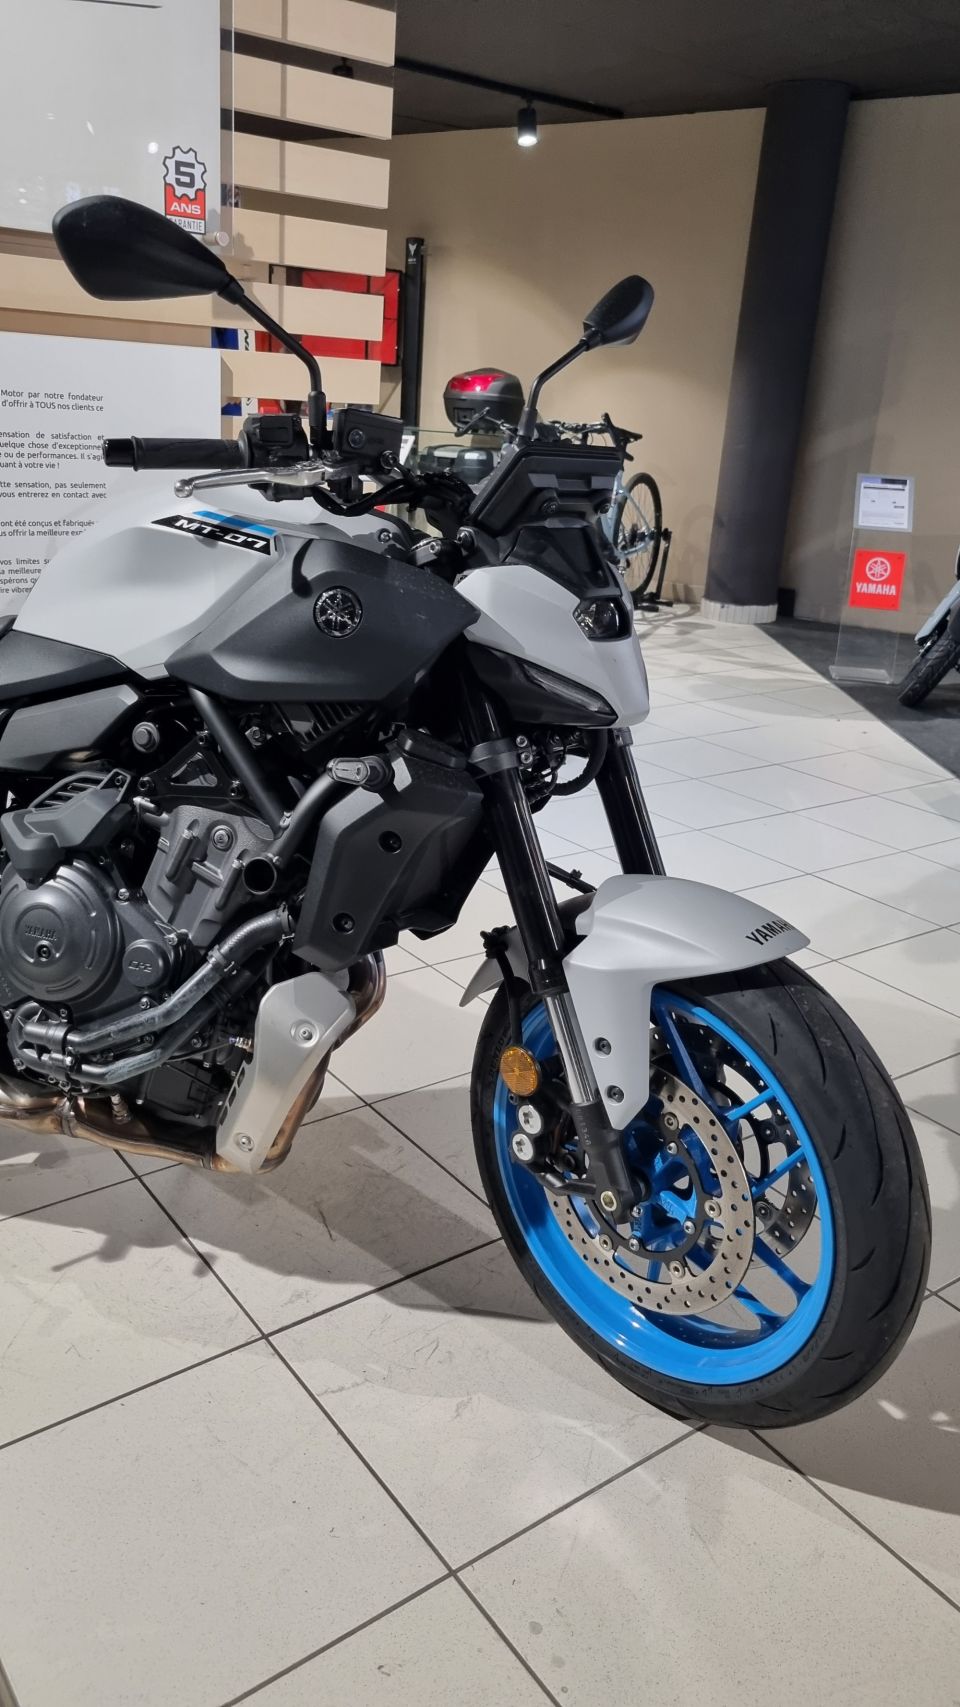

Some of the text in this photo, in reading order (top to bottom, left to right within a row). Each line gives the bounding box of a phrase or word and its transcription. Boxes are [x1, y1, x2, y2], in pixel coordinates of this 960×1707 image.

[174, 159, 196, 189] 5
[170, 202, 201, 216] ANS
[0, 389, 103, 402] Motor par notre fondateur
[1, 399, 28, 408] d'offrir
[29, 401, 34, 409] à
[36, 401, 56, 410] TOUS
[57, 402, 70, 410] nos
[72, 402, 95, 412] clients
[36, 431, 45, 440] de
[51, 431, 92, 441] satisfaction
[28, 441, 49, 450] chose
[16, 450, 25, 459] de
[18, 461, 23, 469] à
[24, 461, 44, 469] votre
[45, 461, 56, 469] vie
[14, 480, 52, 490] sensation,
[54, 482, 67, 490] pas
[70, 481, 106, 489] seulement
[63, 491, 90, 499] contact
[14, 519, 26, 527] été
[28, 520, 53, 529] conçus
[53, 519, 62, 527] et
[8, 529, 27, 537] offrir
[28, 529, 36, 537] la
[36, 529, 70, 537] meilleure
[173, 518, 269, 549] MT-07
[16, 557, 40, 566] limites
[8, 567, 42, 575] meilleure
[855, 582, 897, 596] YAMAHA
